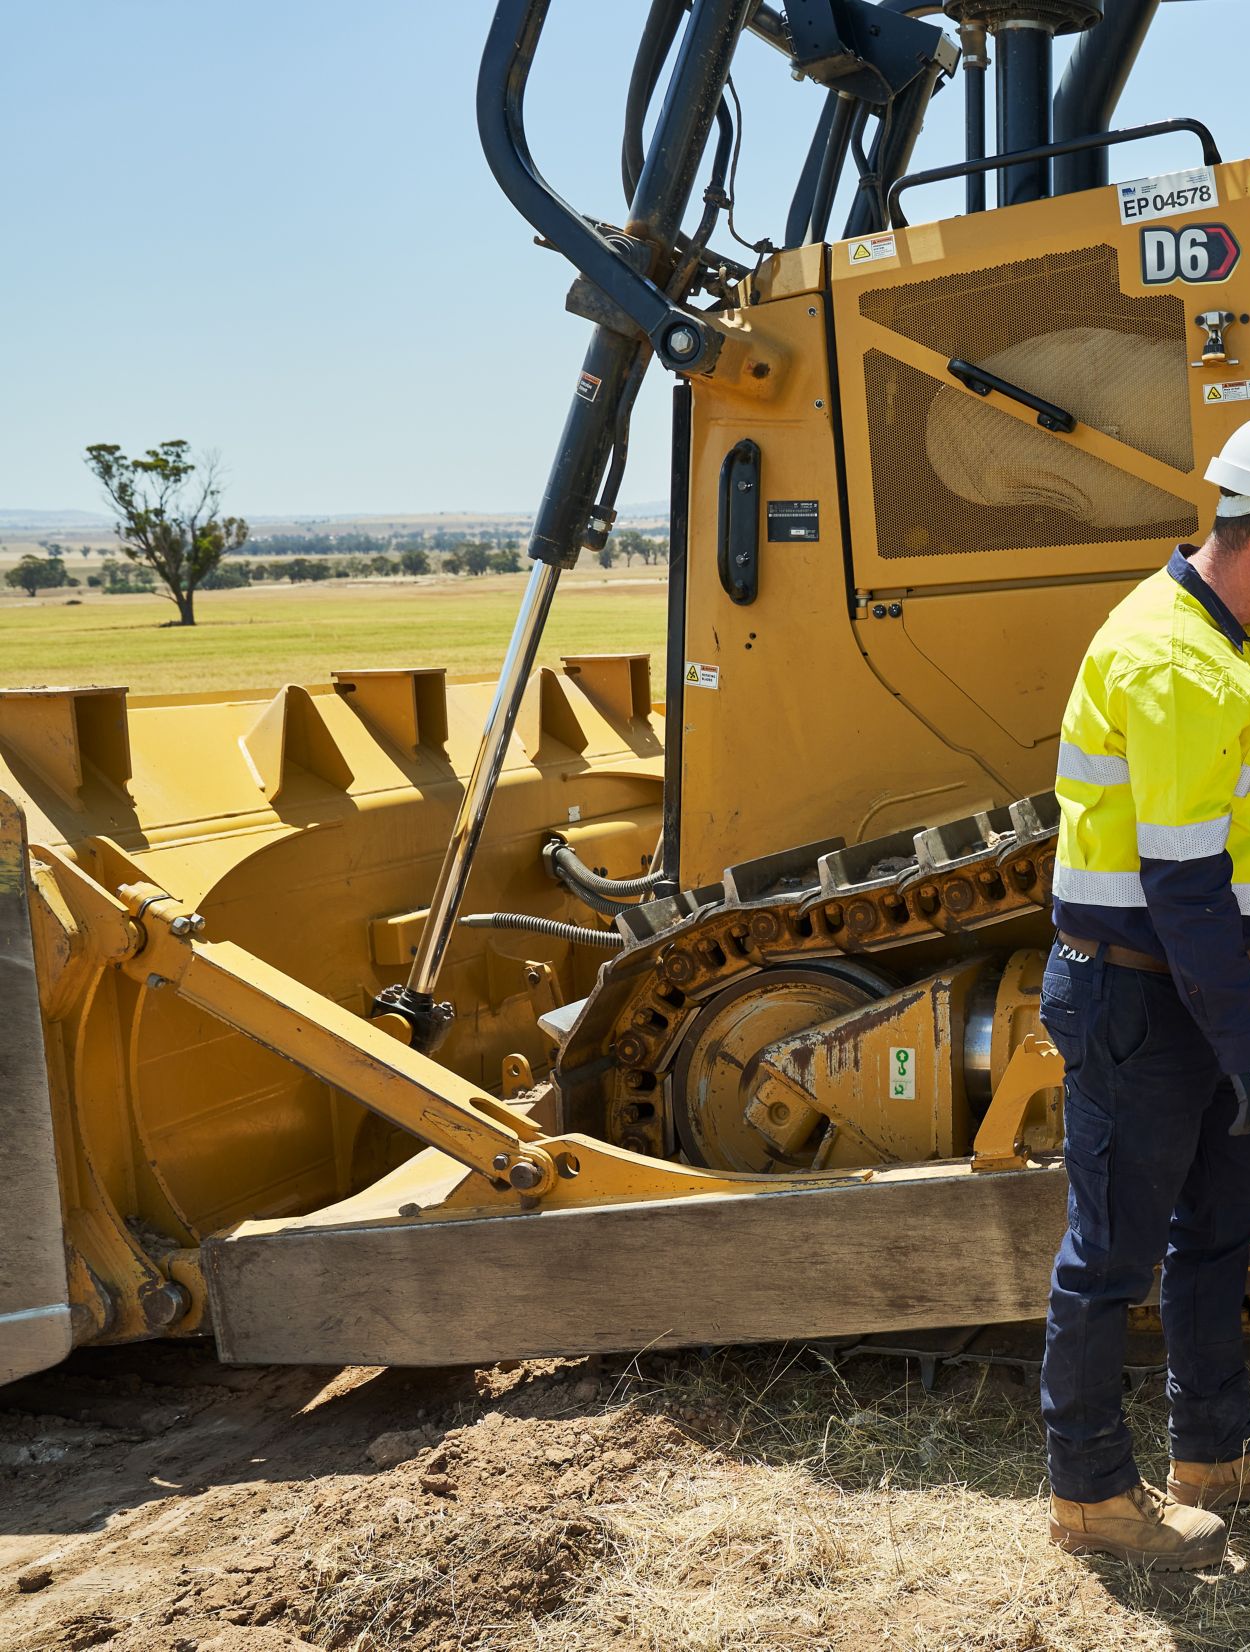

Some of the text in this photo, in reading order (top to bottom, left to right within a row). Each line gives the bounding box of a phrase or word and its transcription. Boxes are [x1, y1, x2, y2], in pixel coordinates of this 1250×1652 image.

[1123, 197, 1149, 218] EP
[1152, 185, 1212, 212] 04578
[1144, 228, 1209, 281] D6
